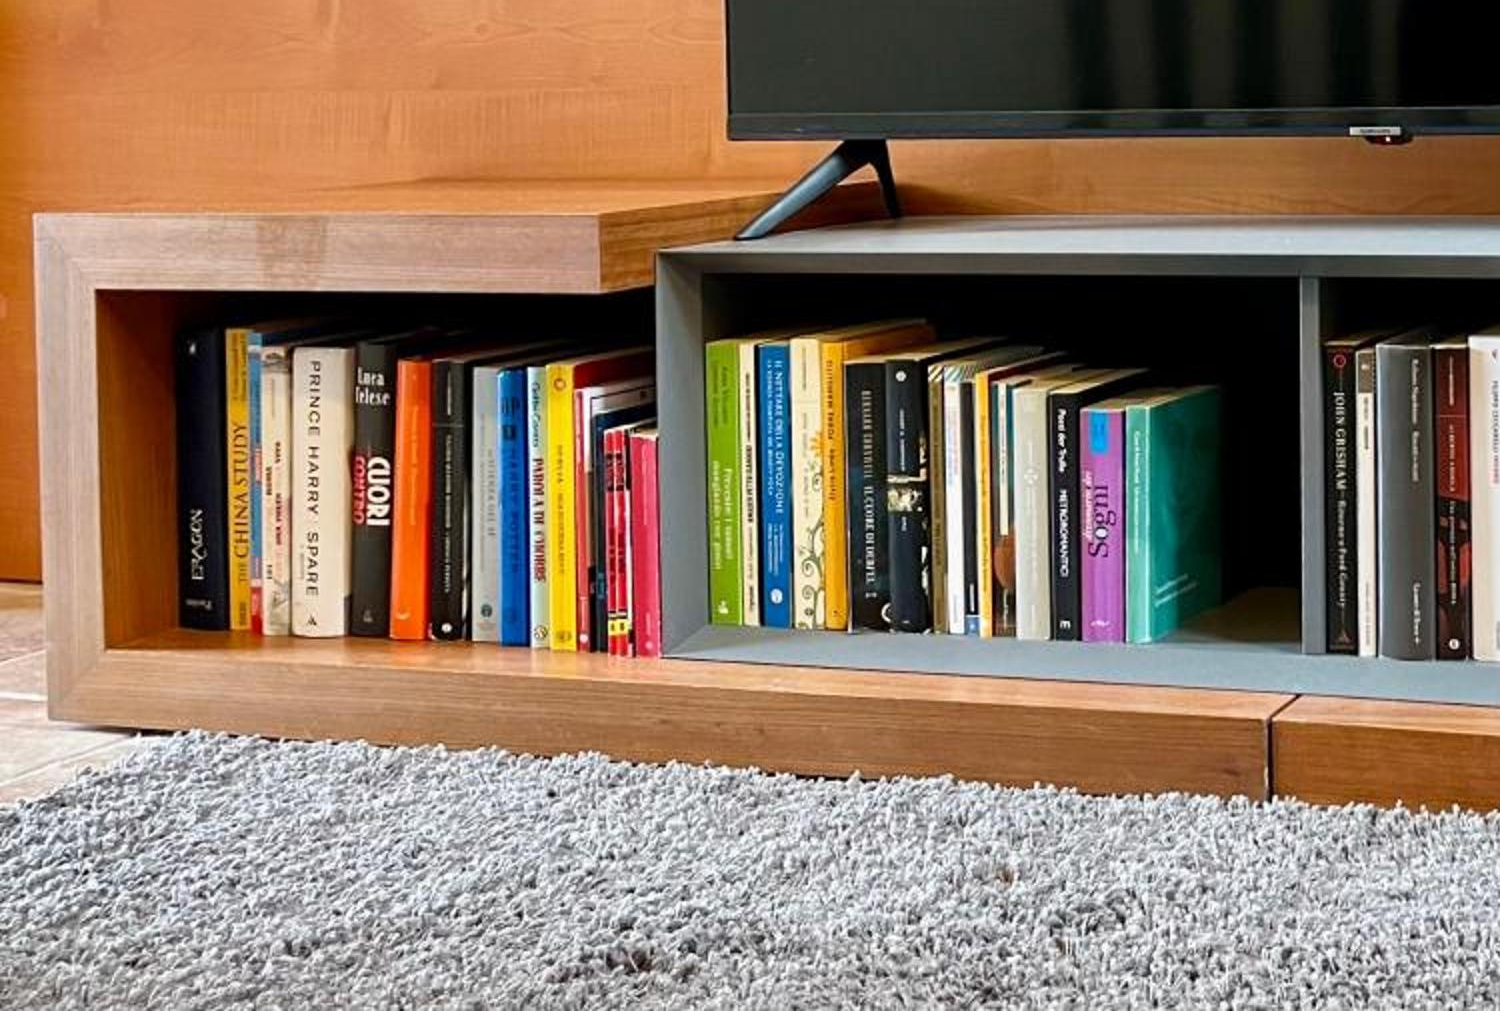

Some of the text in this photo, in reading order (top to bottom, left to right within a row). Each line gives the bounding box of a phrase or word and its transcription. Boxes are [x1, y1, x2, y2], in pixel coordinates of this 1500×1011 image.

[231, 422, 249, 487] STUDY
[1334, 391, 1348, 490] JOHN GRISHAM
[305, 360, 322, 597] PRINCE HARRY SPARE
[352, 455, 367, 526] CONTRO
[366, 456, 392, 527] CUORI
[532, 457, 546, 506] PAROLA
[775, 451, 786, 514] DEVOZIONE
[190, 508, 208, 580] ERAGON
[232, 492, 249, 558] CHINA
[1087, 484, 1117, 559] Sogni
[1338, 548, 1348, 571] Ford
